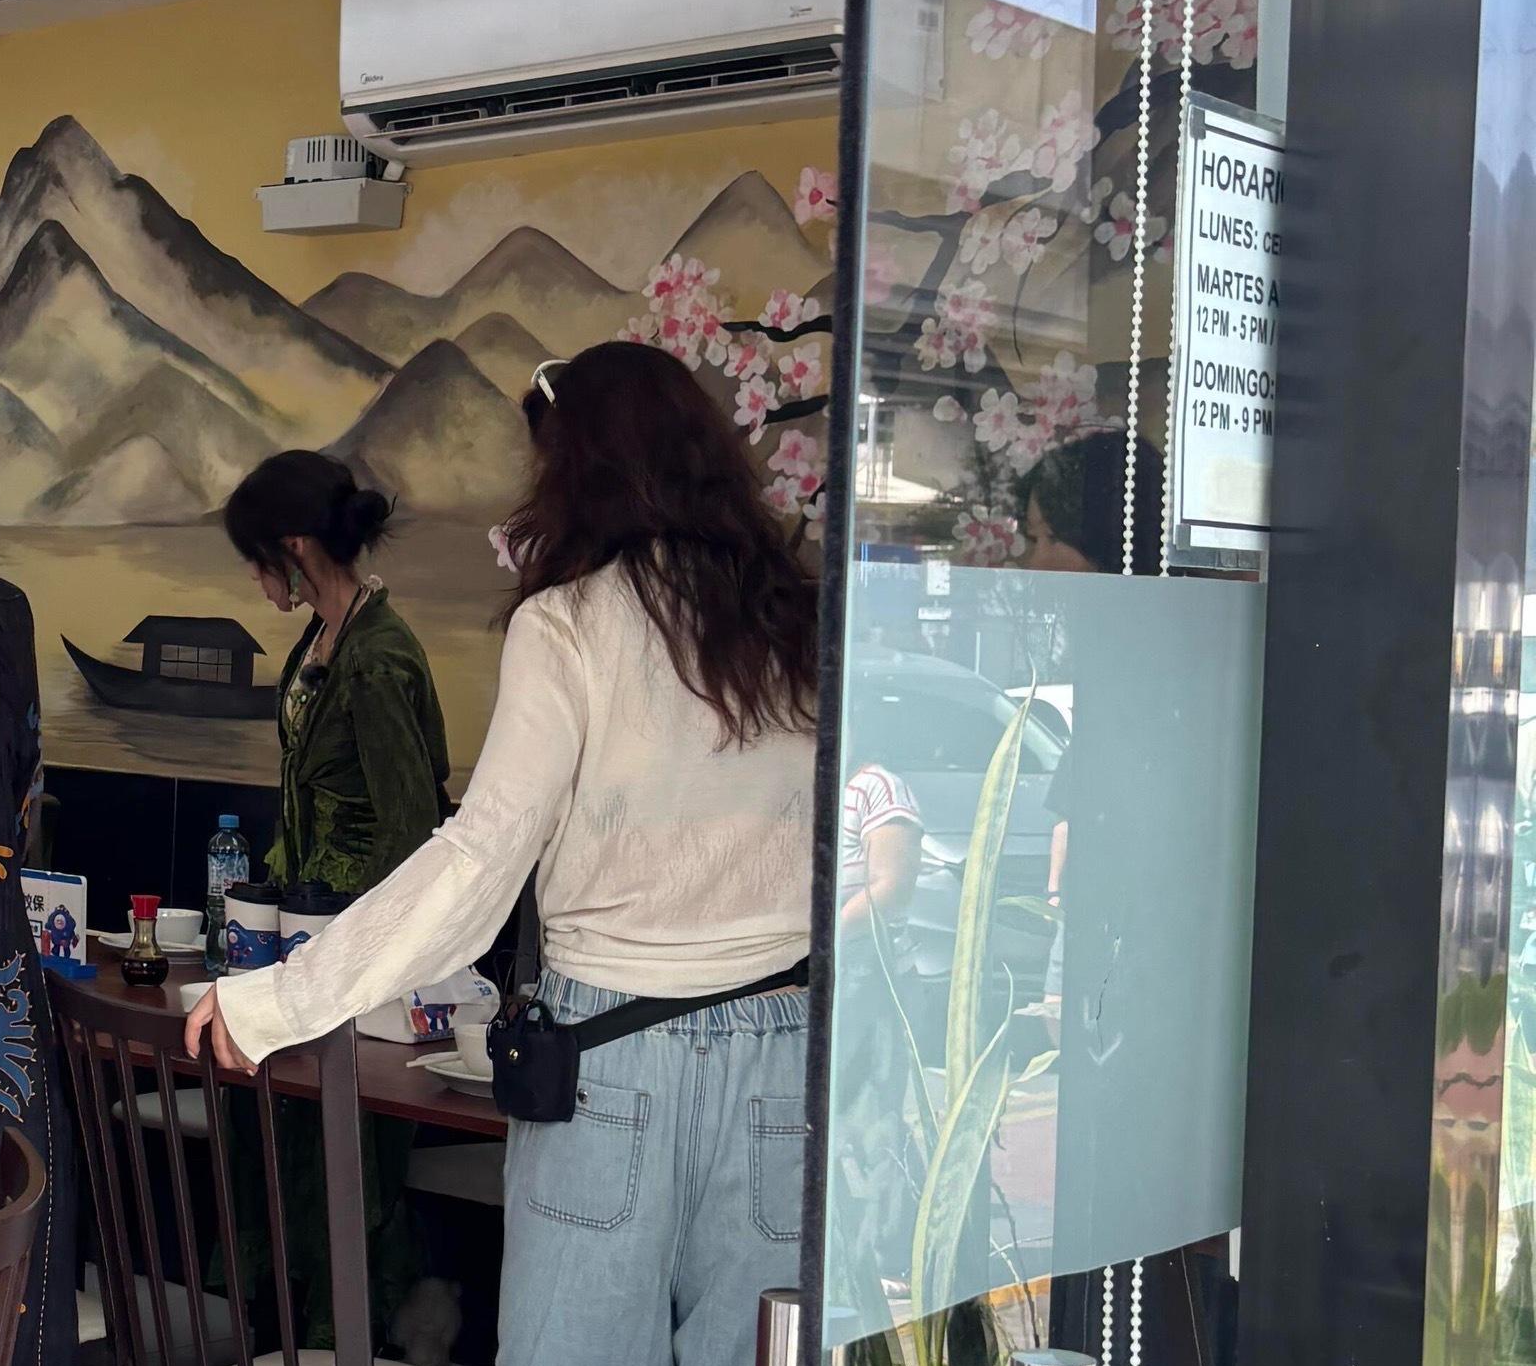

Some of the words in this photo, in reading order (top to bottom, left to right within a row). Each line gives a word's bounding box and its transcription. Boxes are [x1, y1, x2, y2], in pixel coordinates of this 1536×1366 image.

[1199, 209, 1258, 250] LUNES:
[1263, 232, 1282, 255] CE
[1197, 263, 1264, 305] MARTES
[1268, 280, 1279, 308] A
[1197, 305, 1208, 333] 12
[1212, 309, 1230, 337] PM
[1239, 315, 1247, 340] 5
[1250, 316, 1268, 343] PM
[1193, 359, 1275, 399] DOMINGO:
[1192, 399, 1206, 426] 12
[1211, 402, 1230, 430] PM
[1242, 407, 1249, 432] 9
[1253, 409, 1273, 436] PM
